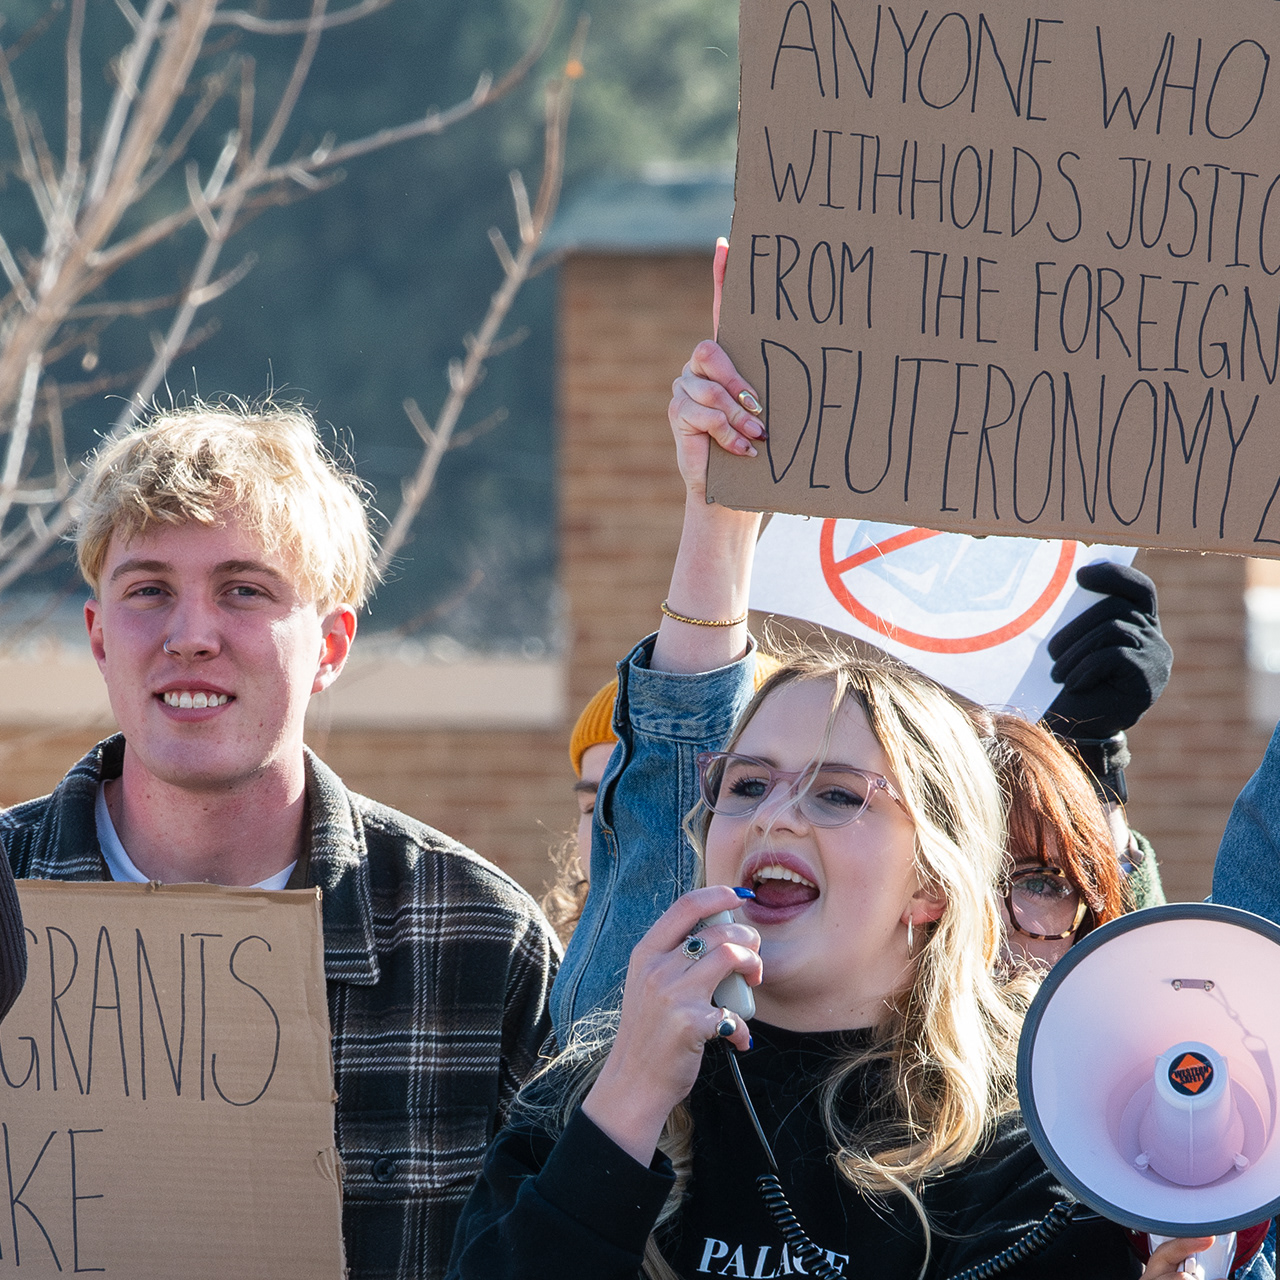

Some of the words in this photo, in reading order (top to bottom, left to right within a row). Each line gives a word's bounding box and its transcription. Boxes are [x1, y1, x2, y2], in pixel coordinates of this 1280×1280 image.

[770, 0, 1064, 122] ANYONE
[1096, 25, 1269, 139] WHO
[764, 126, 1083, 243] WITHHOLDS
[749, 233, 875, 330] FROM
[910, 249, 1000, 344] THE
[761, 340, 1260, 539] DEUTERONOMY
